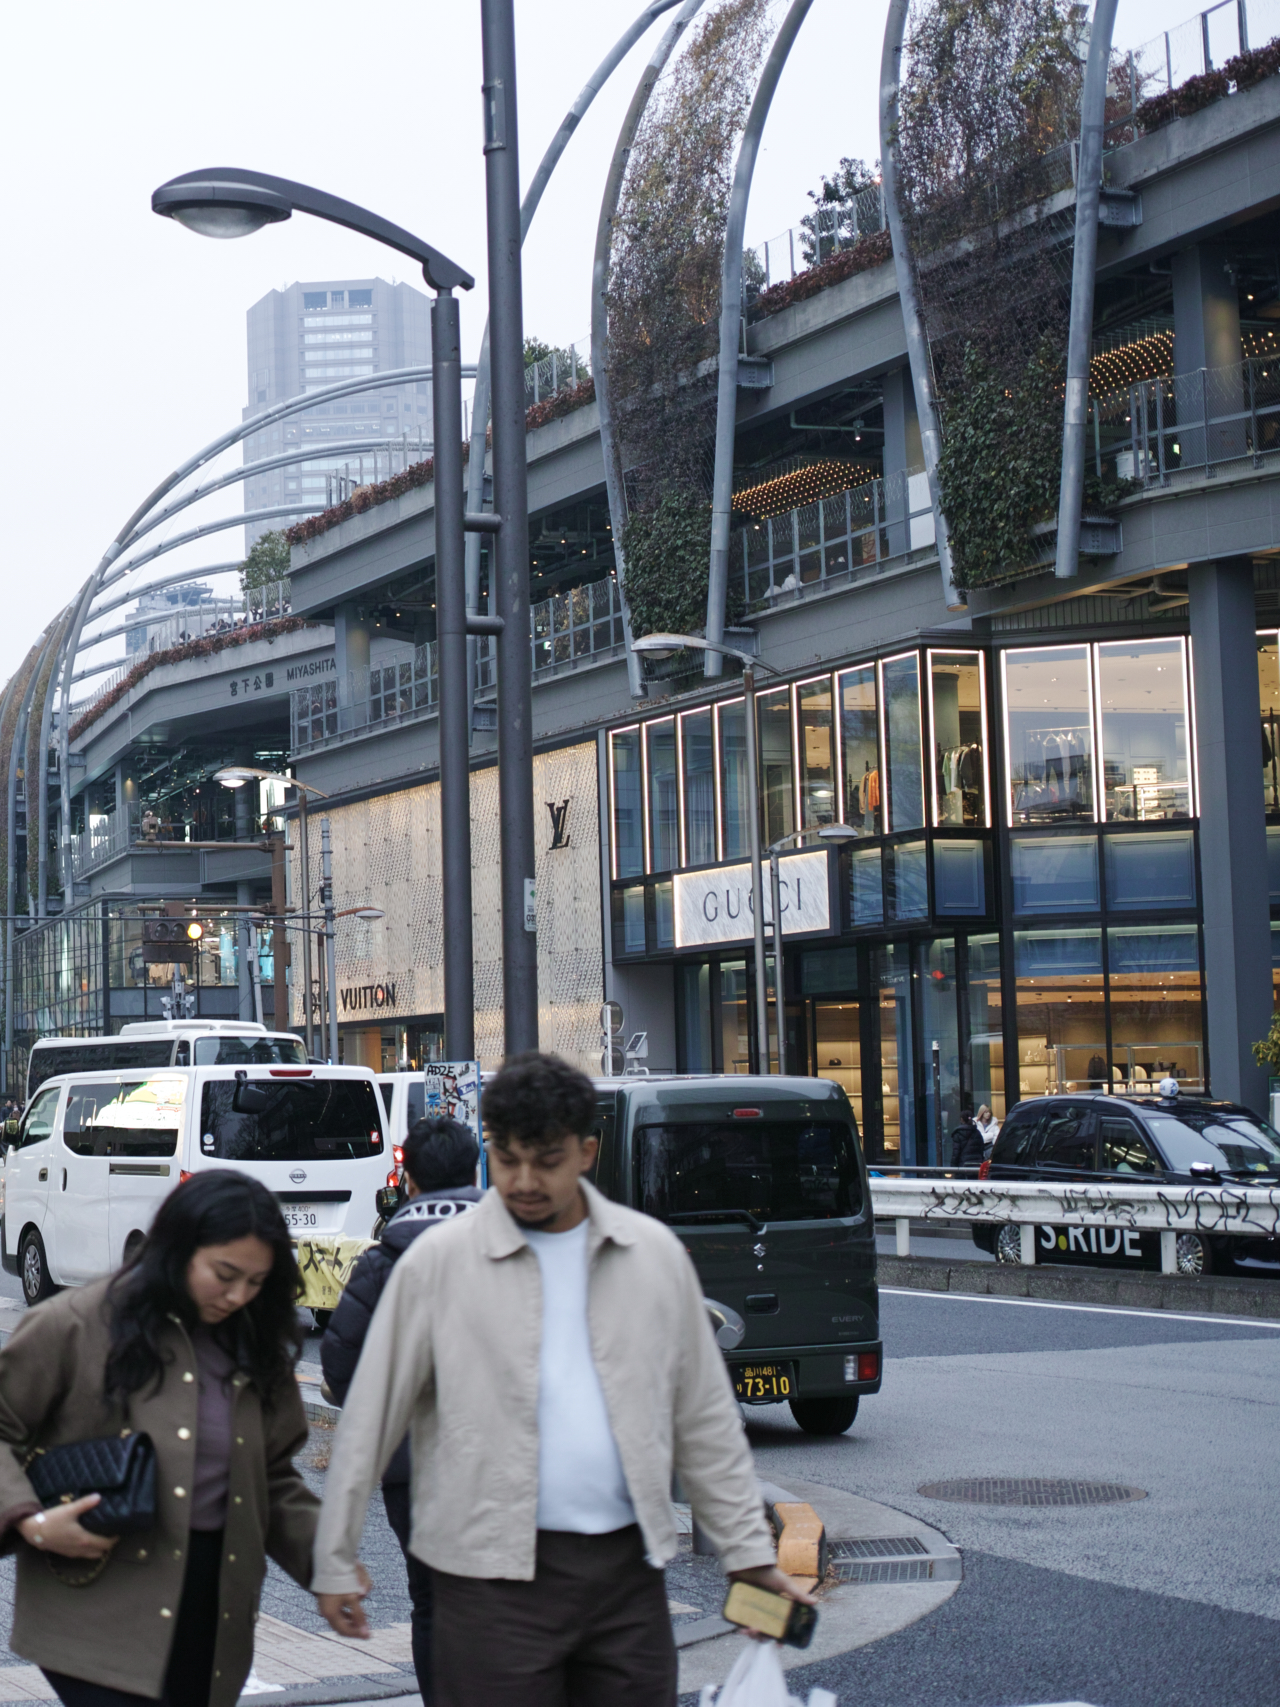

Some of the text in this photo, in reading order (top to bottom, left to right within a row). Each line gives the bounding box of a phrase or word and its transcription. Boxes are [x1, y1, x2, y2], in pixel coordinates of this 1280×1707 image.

[229, 657, 337, 697] 宮下公園 MIYASHITA
[340, 982, 396, 1013] VUITTON
[831, 1314, 865, 1323] EVERY
[744, 1376, 790, 1397] 73-10
